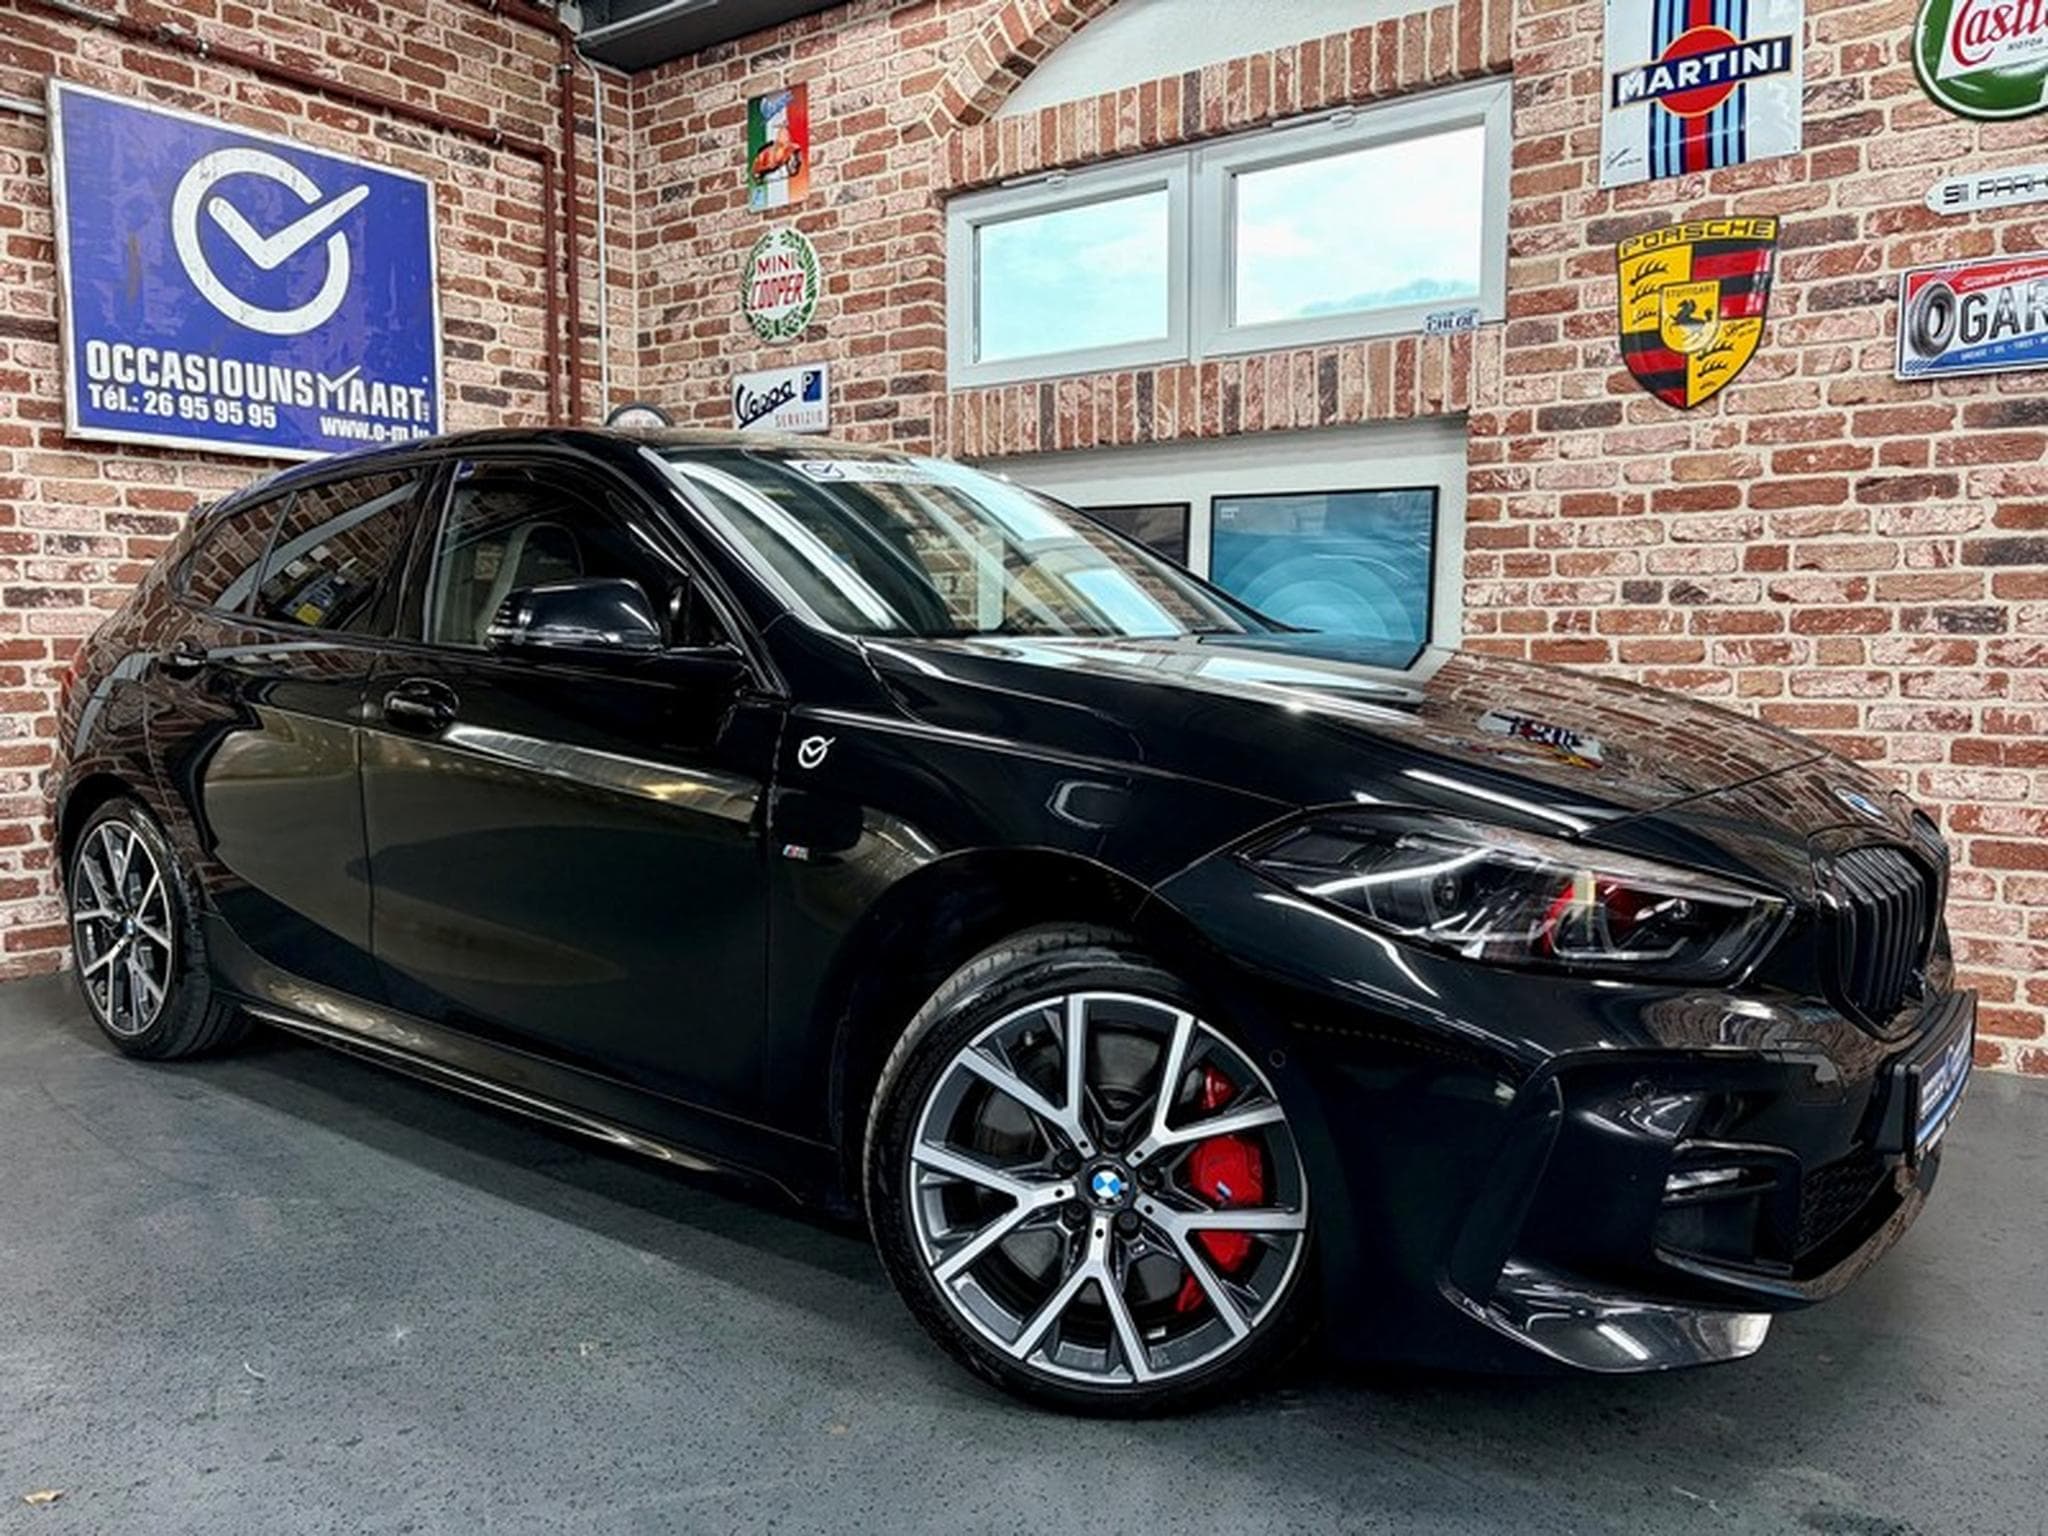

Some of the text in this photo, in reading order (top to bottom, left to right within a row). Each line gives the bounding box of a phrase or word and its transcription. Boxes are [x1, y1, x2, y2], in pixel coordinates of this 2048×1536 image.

[1618, 41, 1783, 102] MARTINI
[1623, 219, 1772, 256] PORSCHE
[757, 251, 795, 275] MINI
[750, 272, 804, 311] COOPER
[88, 383, 278, 429] Tél.: 26 95 95 95
[736, 380, 797, 429] Vespa
